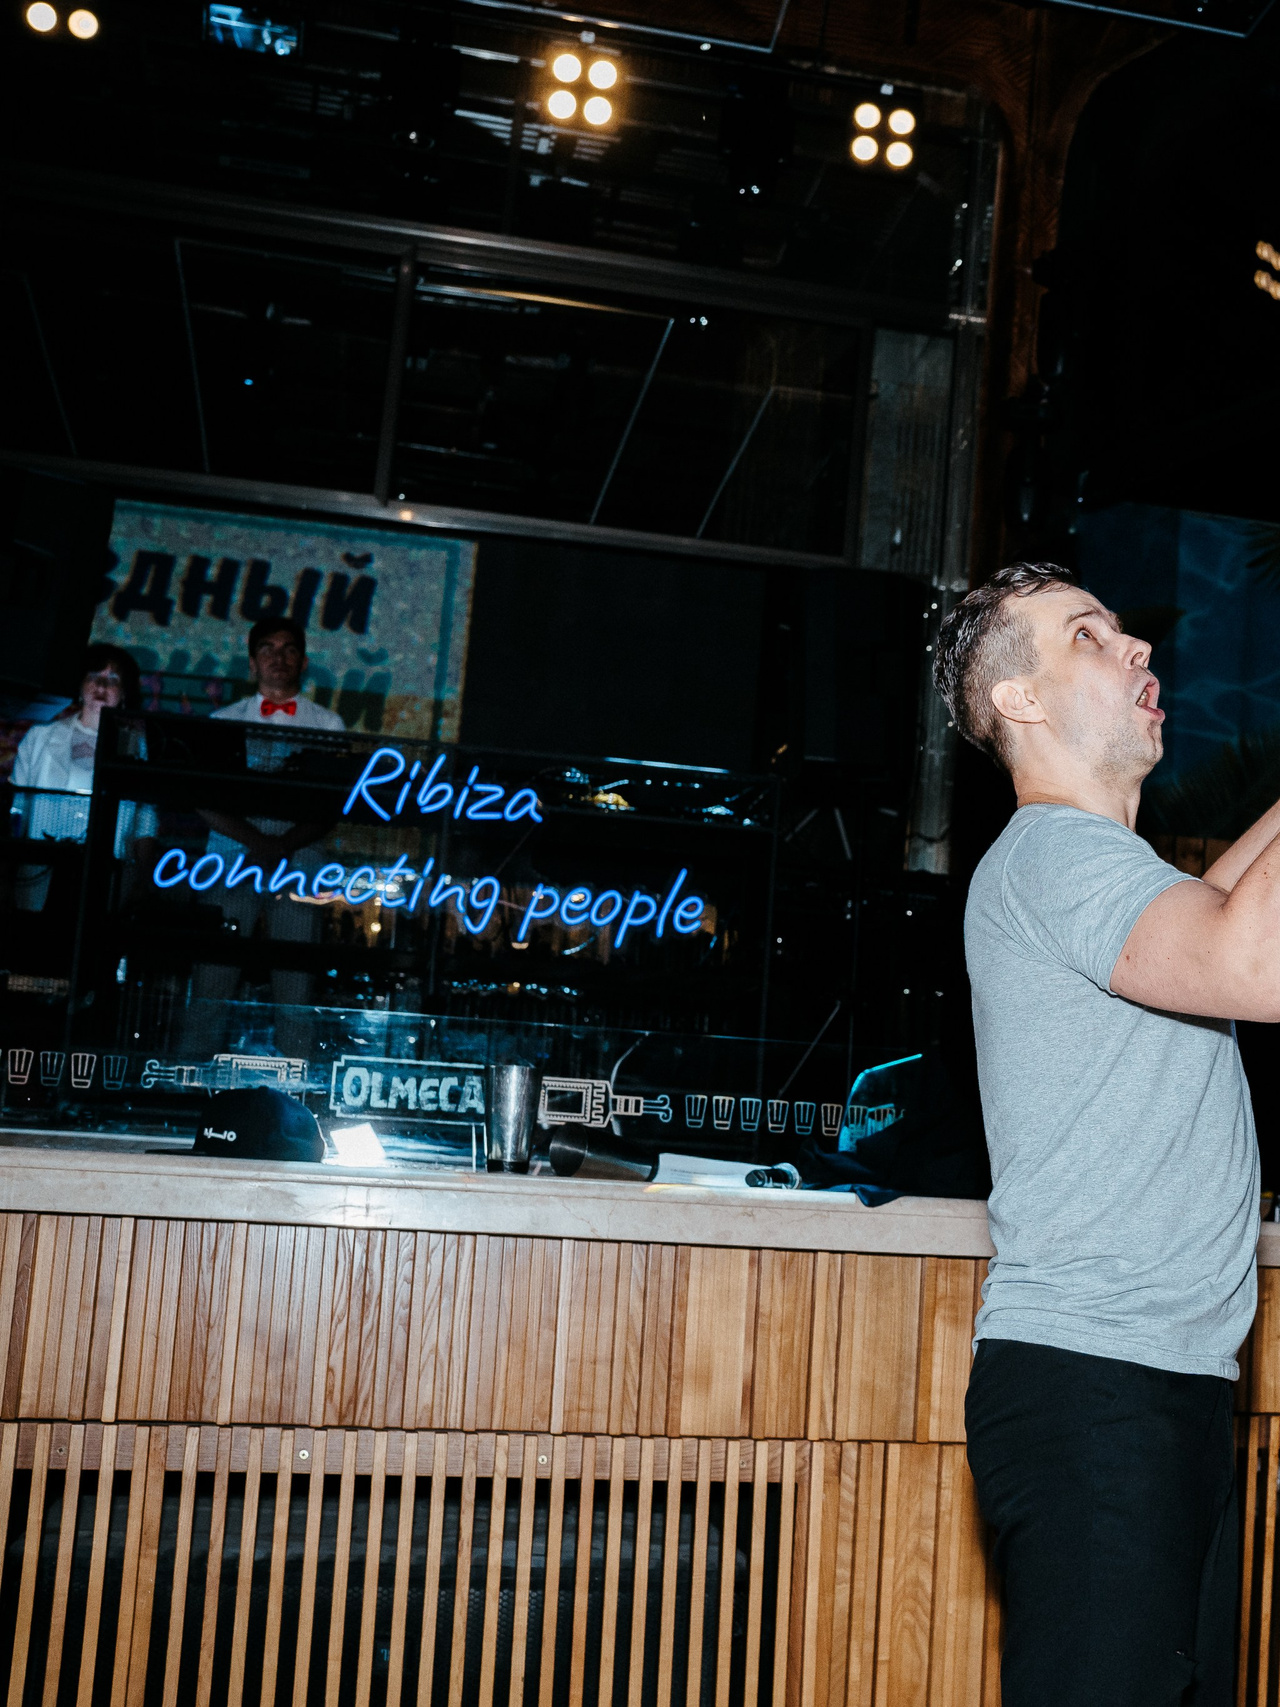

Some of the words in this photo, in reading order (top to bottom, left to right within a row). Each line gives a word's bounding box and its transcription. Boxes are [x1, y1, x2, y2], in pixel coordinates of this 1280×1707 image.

[343, 747, 543, 822] Ribiza
[153, 848, 500, 935] connecting
[516, 868, 705, 948] people
[342, 1066, 486, 1115] OLMECA
